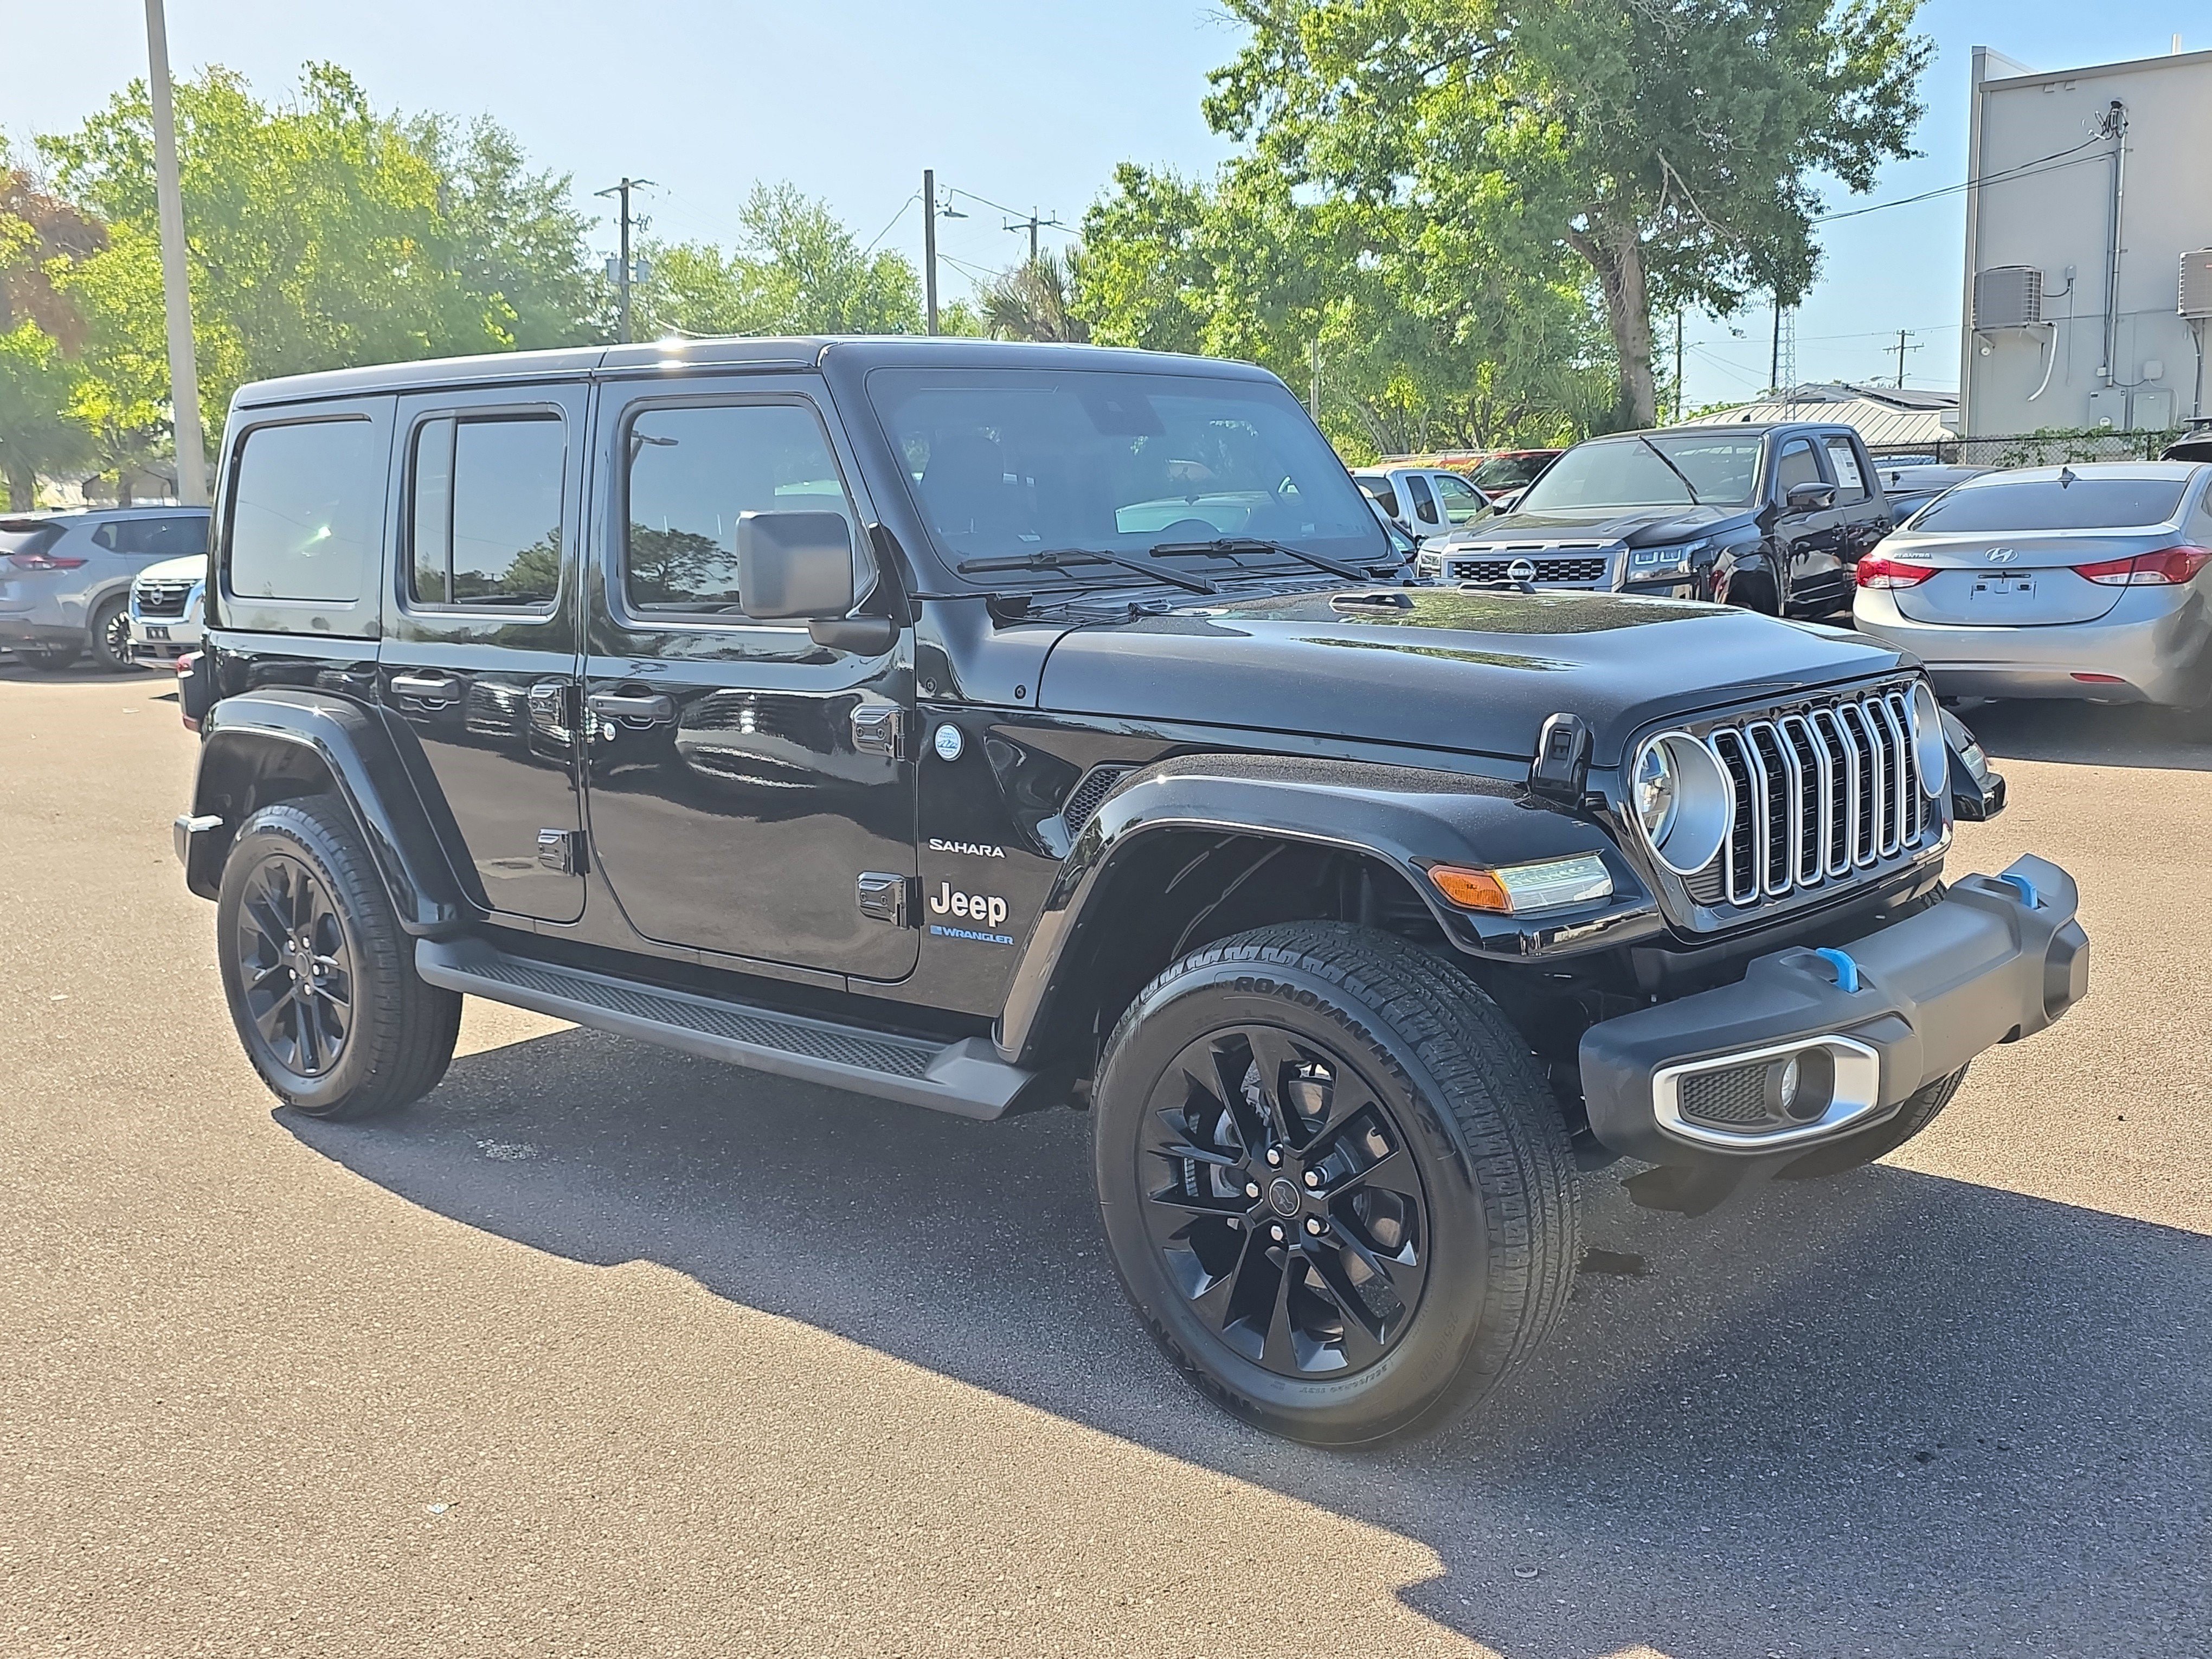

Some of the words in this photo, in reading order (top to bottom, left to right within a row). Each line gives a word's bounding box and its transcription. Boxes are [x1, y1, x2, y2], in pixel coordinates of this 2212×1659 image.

[929, 838, 1005, 858] SAHARA
[930, 882, 1007, 927] Jeep
[942, 927, 1014, 946] WRANGLER
[1234, 976, 1371, 1041] ROADIAN
